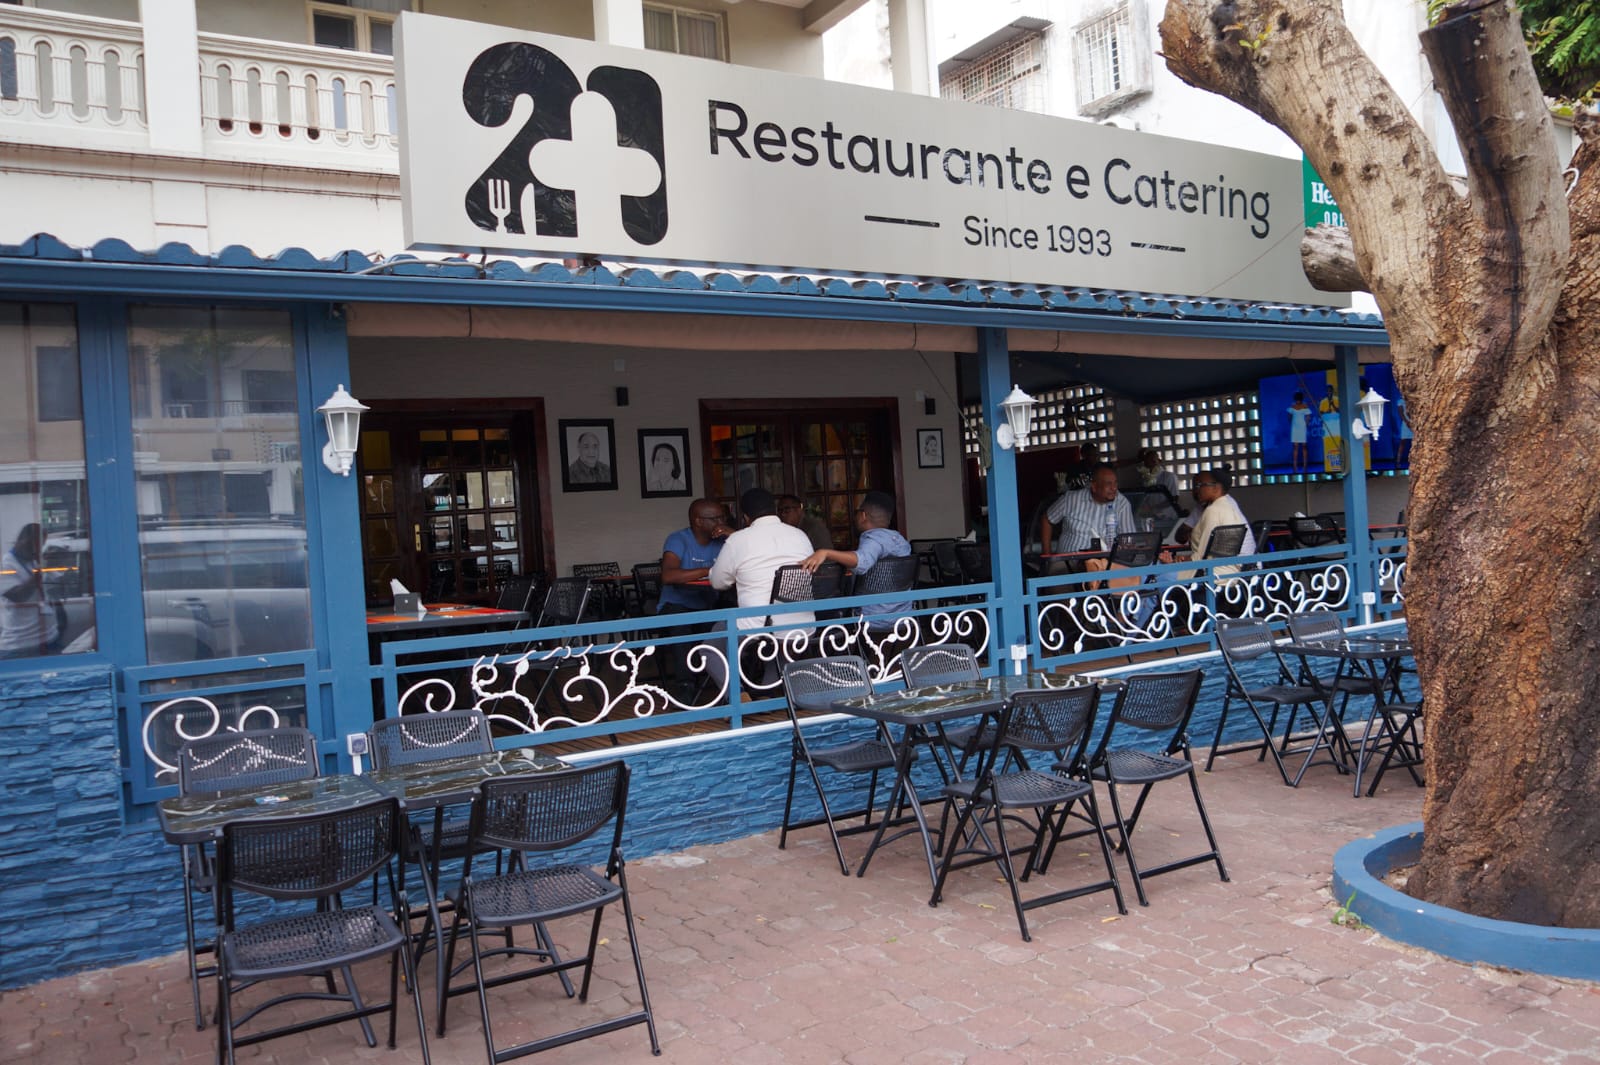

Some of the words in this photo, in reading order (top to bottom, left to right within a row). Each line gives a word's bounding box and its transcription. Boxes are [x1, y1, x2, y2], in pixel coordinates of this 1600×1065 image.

[708, 99, 1052, 195] Restaurante
[1066, 164, 1091, 200] e
[1104, 158, 1271, 240] Catering
[1311, 181, 1338, 206] He
[963, 215, 1040, 250] Since
[1046, 224, 1112, 257] 1993
